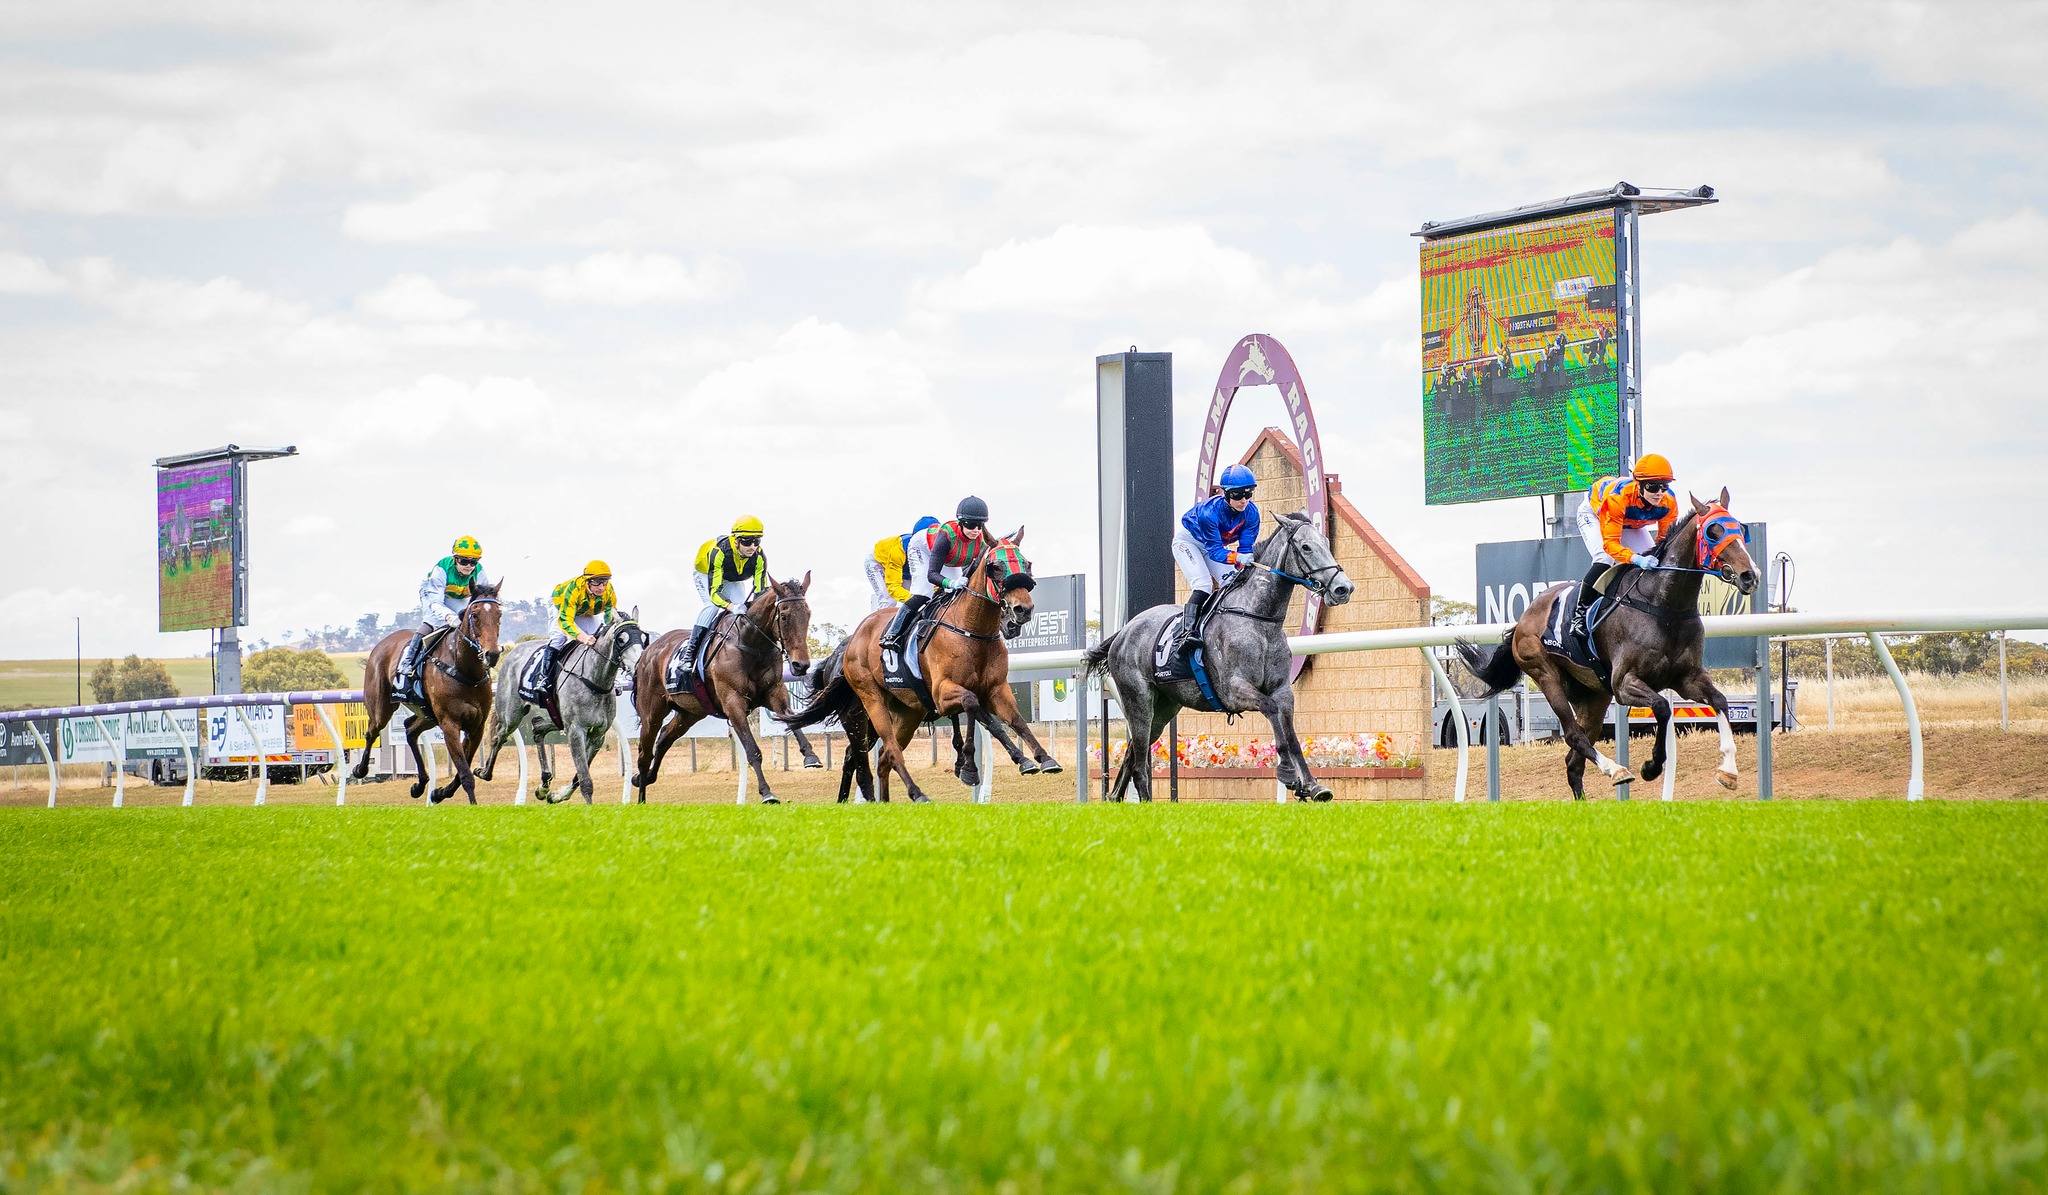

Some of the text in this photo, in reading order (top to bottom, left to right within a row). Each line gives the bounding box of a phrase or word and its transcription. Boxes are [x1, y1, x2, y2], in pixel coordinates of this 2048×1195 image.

[1199, 388, 1225, 493] HAM
[1287, 381, 1321, 496] RACE
[1019, 637, 1048, 648] ENTERPRISE
[1050, 635, 1068, 645] ESTATE
[161, 711, 195, 732] CONRACTORS
[235, 705, 274, 721] DMIANS
[296, 708, 317, 721] TRIPLE
[11, 732, 22, 746] Avon
[22, 730, 35, 748] Valley
